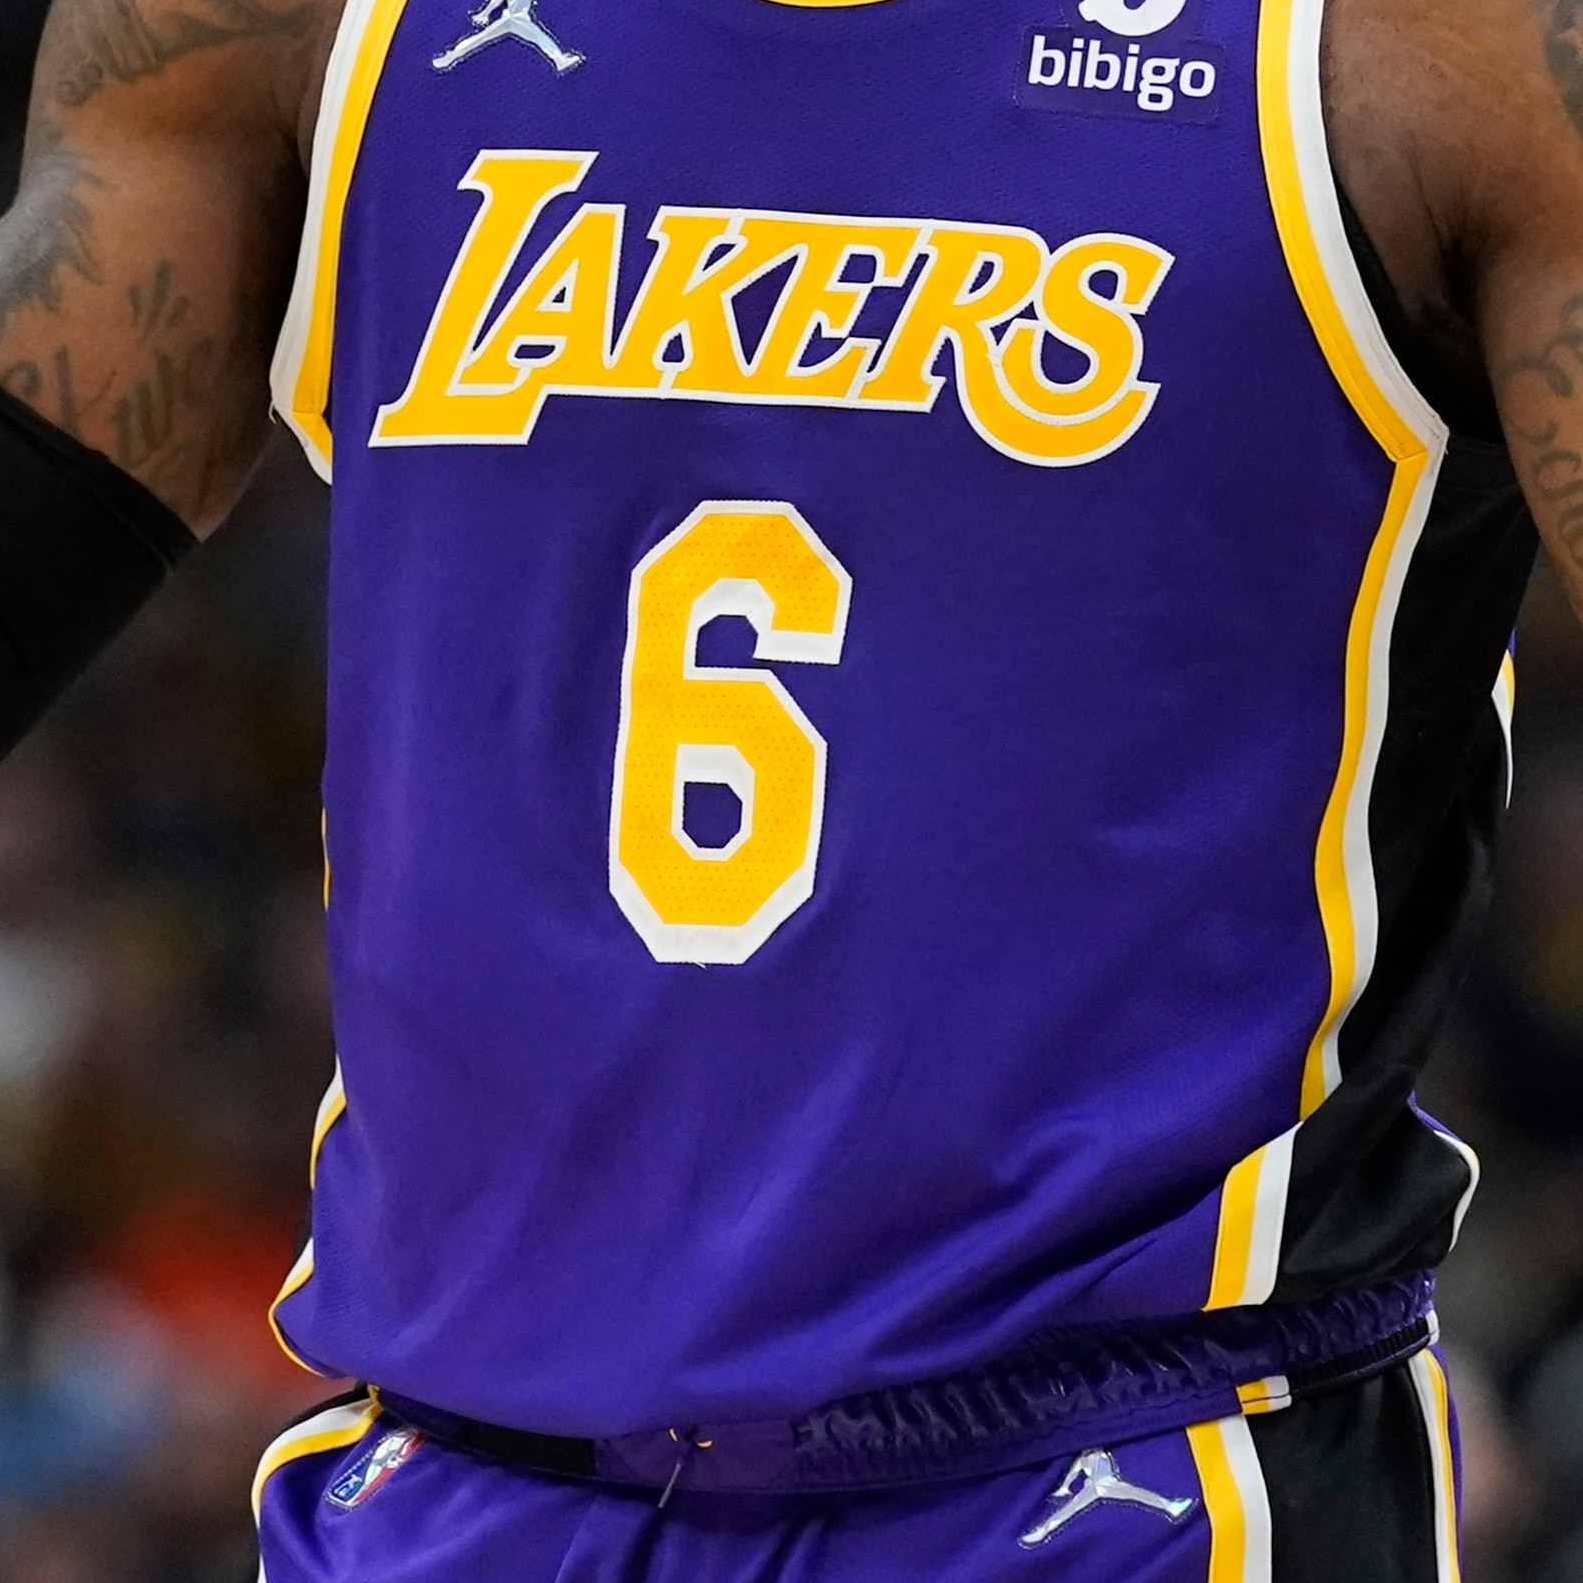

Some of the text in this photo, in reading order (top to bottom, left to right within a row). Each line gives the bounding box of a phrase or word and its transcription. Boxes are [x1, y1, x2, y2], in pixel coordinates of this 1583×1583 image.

[1028, 34, 1216, 112] bibigo
[368, 148, 1176, 468] LAKERS
[608, 499, 854, 965] 6
